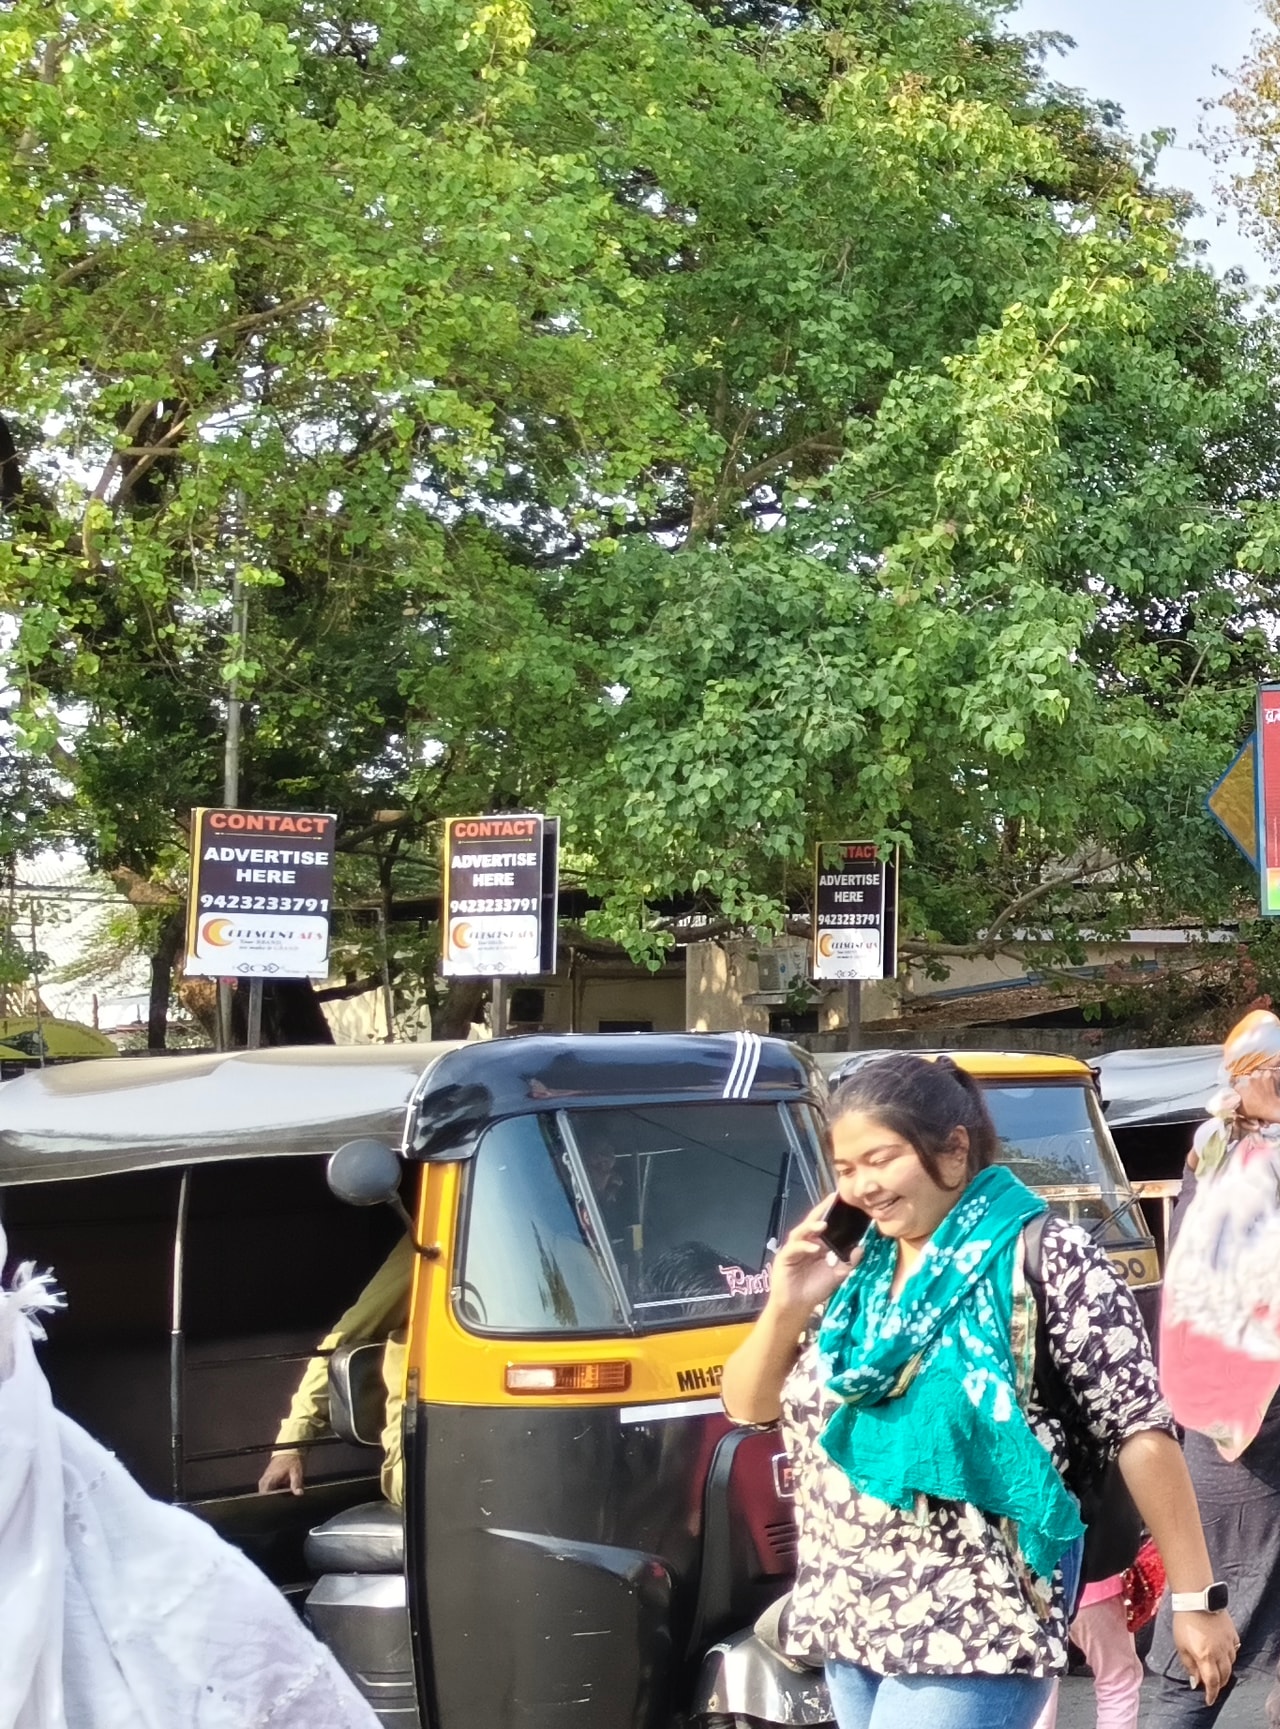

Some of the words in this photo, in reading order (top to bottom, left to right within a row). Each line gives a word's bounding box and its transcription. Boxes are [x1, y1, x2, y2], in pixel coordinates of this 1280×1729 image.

[210, 813, 329, 833] CONTACT
[454, 820, 536, 837] CONTACT
[204, 847, 329, 865] ADVERTISE
[451, 853, 537, 869] ADVERTISE
[236, 869, 296, 884] HERE
[472, 873, 514, 887] HERE
[819, 874, 880, 886] ADVERTISE
[200, 894, 329, 912] 9423233791
[834, 891, 864, 902] HERE
[450, 898, 537, 913] 9423233791
[818, 914, 880, 925] 9423233791
